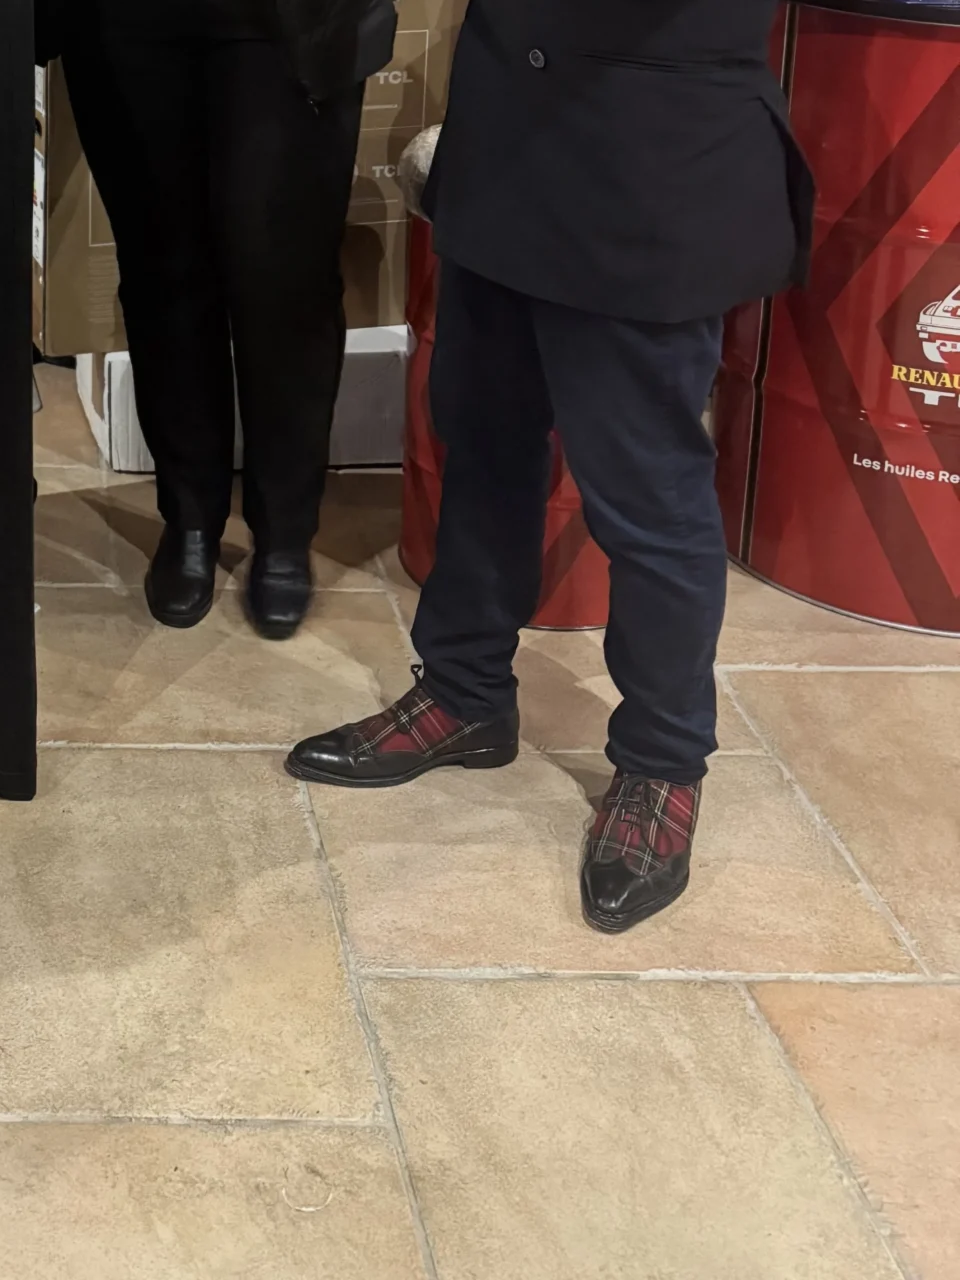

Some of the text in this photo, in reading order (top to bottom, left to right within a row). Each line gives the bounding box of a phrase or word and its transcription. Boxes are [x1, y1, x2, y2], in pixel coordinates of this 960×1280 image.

[375, 71, 414, 85] TCL
[853, 453, 960, 484] Les huiles Re
